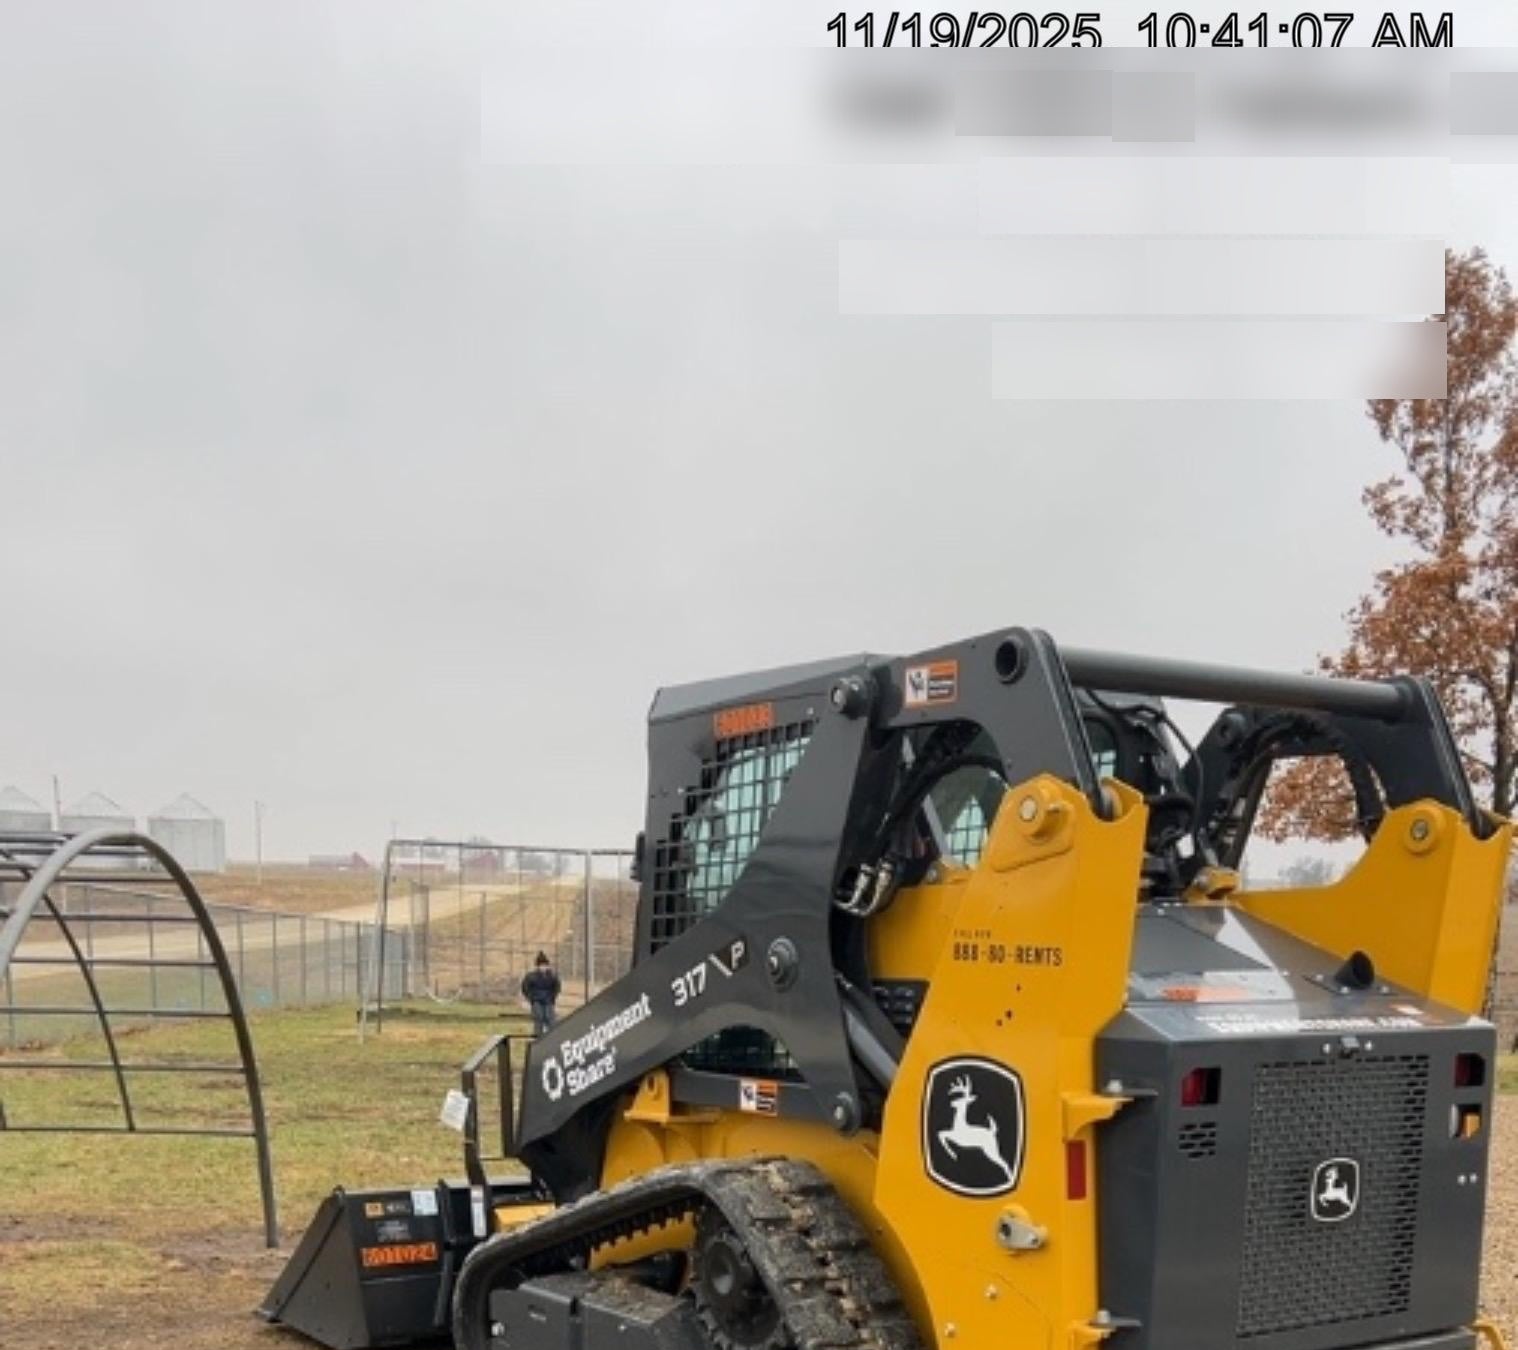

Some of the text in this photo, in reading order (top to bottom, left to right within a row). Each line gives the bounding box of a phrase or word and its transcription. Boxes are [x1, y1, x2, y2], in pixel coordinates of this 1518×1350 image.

[671, 961, 706, 1007] 317
[560, 992, 652, 1067] Equipment
[566, 1052, 616, 1096] Share
